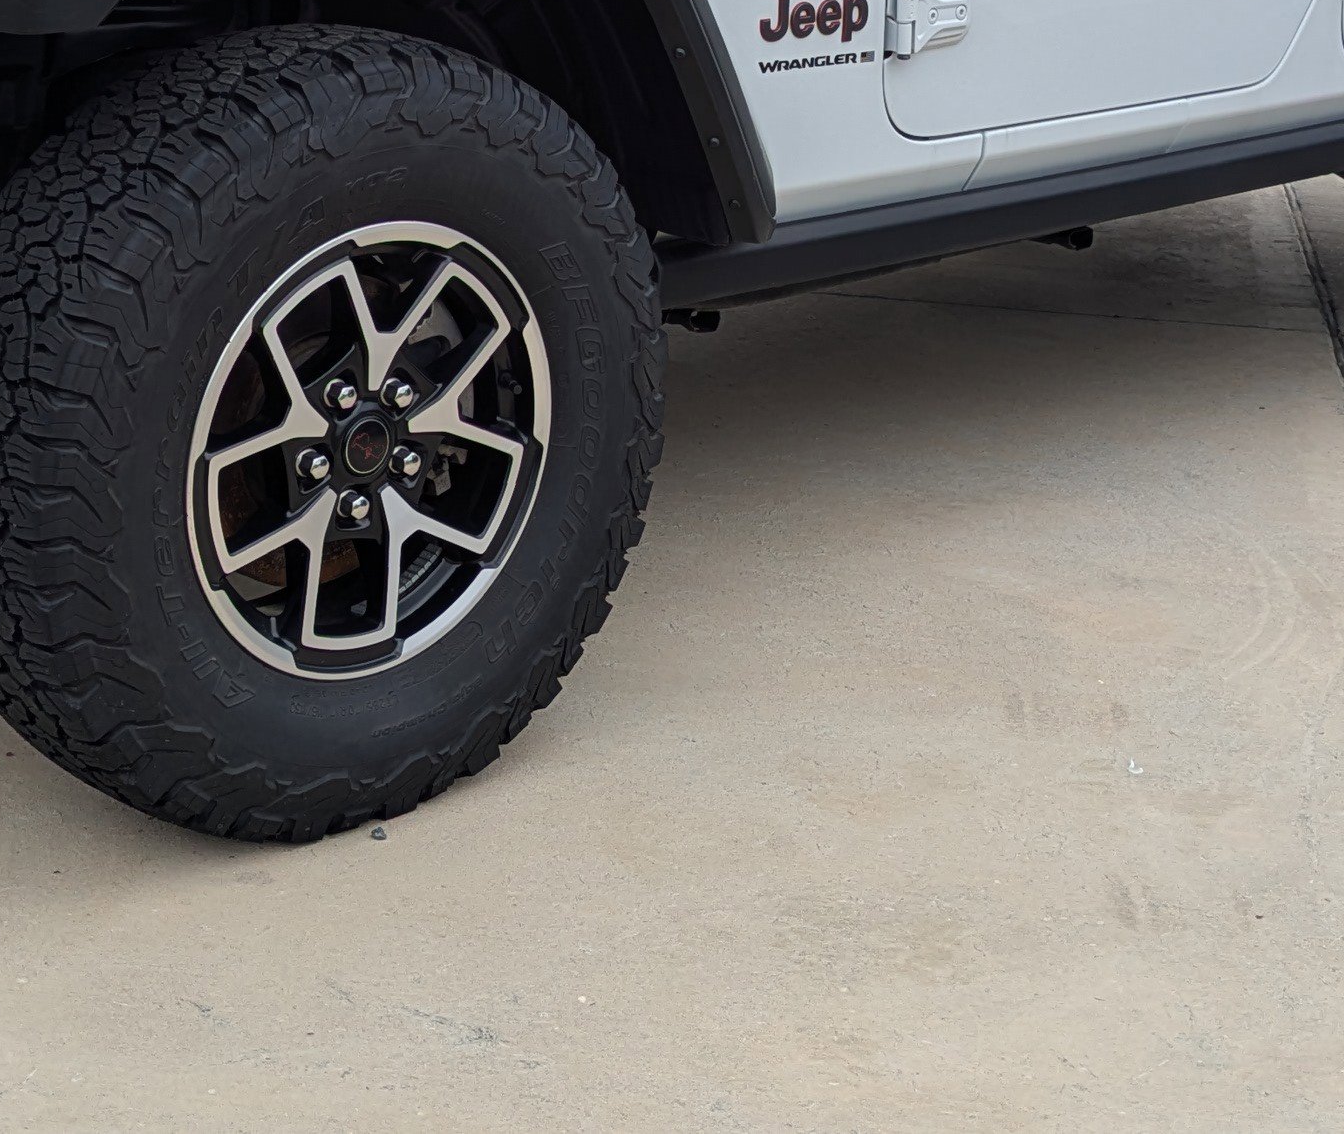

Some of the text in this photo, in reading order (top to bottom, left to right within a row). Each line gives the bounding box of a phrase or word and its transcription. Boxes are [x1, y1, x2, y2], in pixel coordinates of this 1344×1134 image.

[758, 52, 858, 74] WRANGLER
[153, 306, 256, 709] All-Terrain
[226, 195, 326, 298] T/A
[485, 241, 606, 664] BFGoodrich
